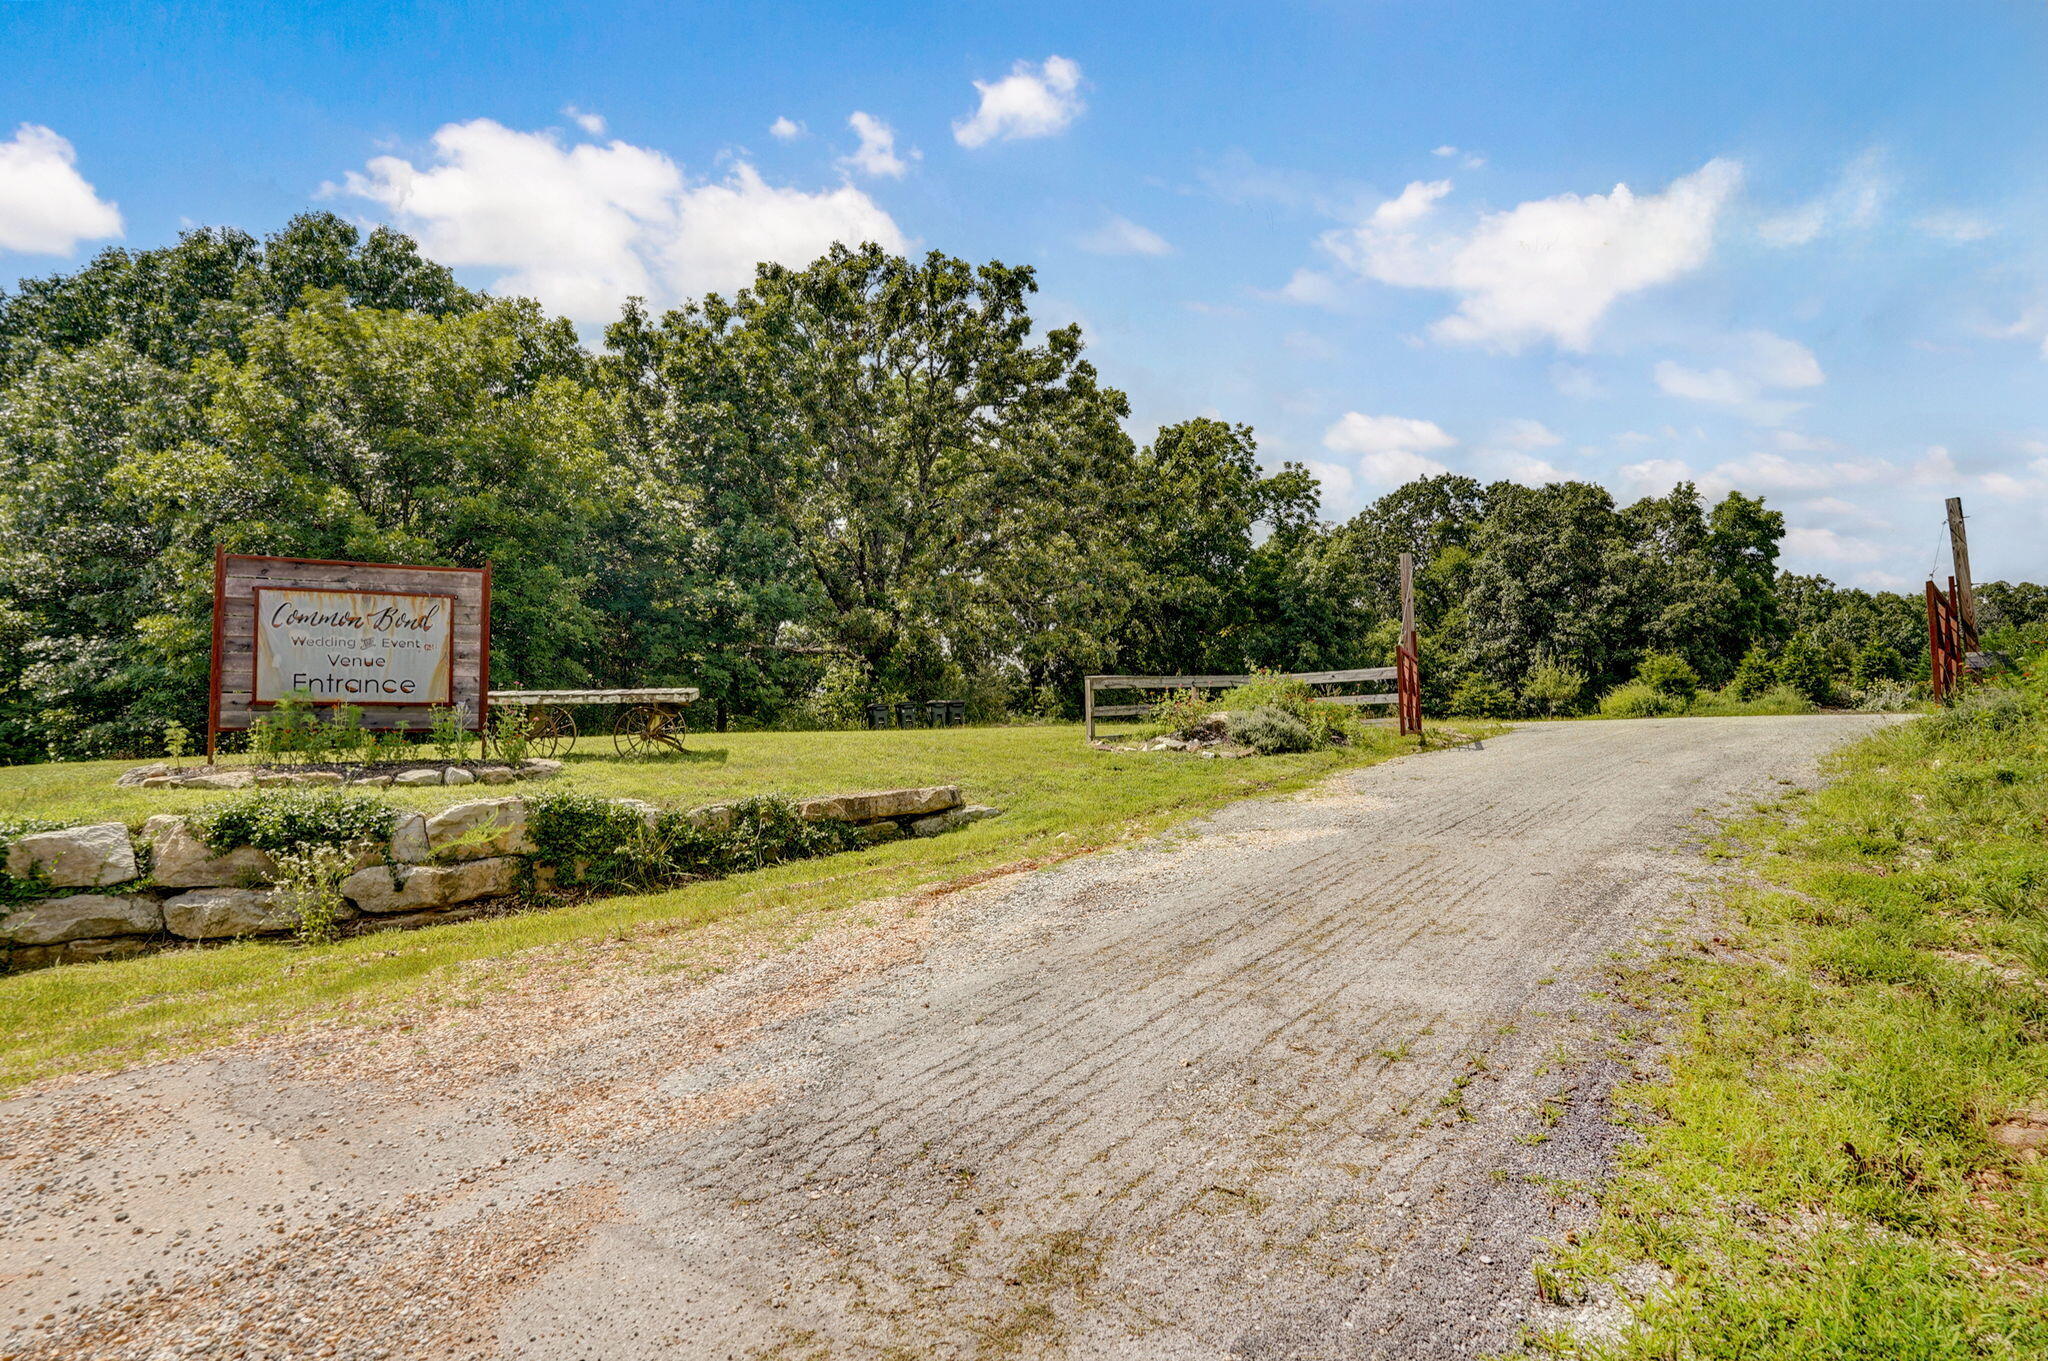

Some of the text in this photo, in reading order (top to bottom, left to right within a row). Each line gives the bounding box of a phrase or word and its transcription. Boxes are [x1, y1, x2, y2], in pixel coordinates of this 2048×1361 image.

[271, 602, 440, 632] Common Bond
[291, 636, 356, 649] Wedding
[382, 638, 420, 649] Event
[327, 654, 386, 667] Venue
[293, 673, 416, 694] Entrance
